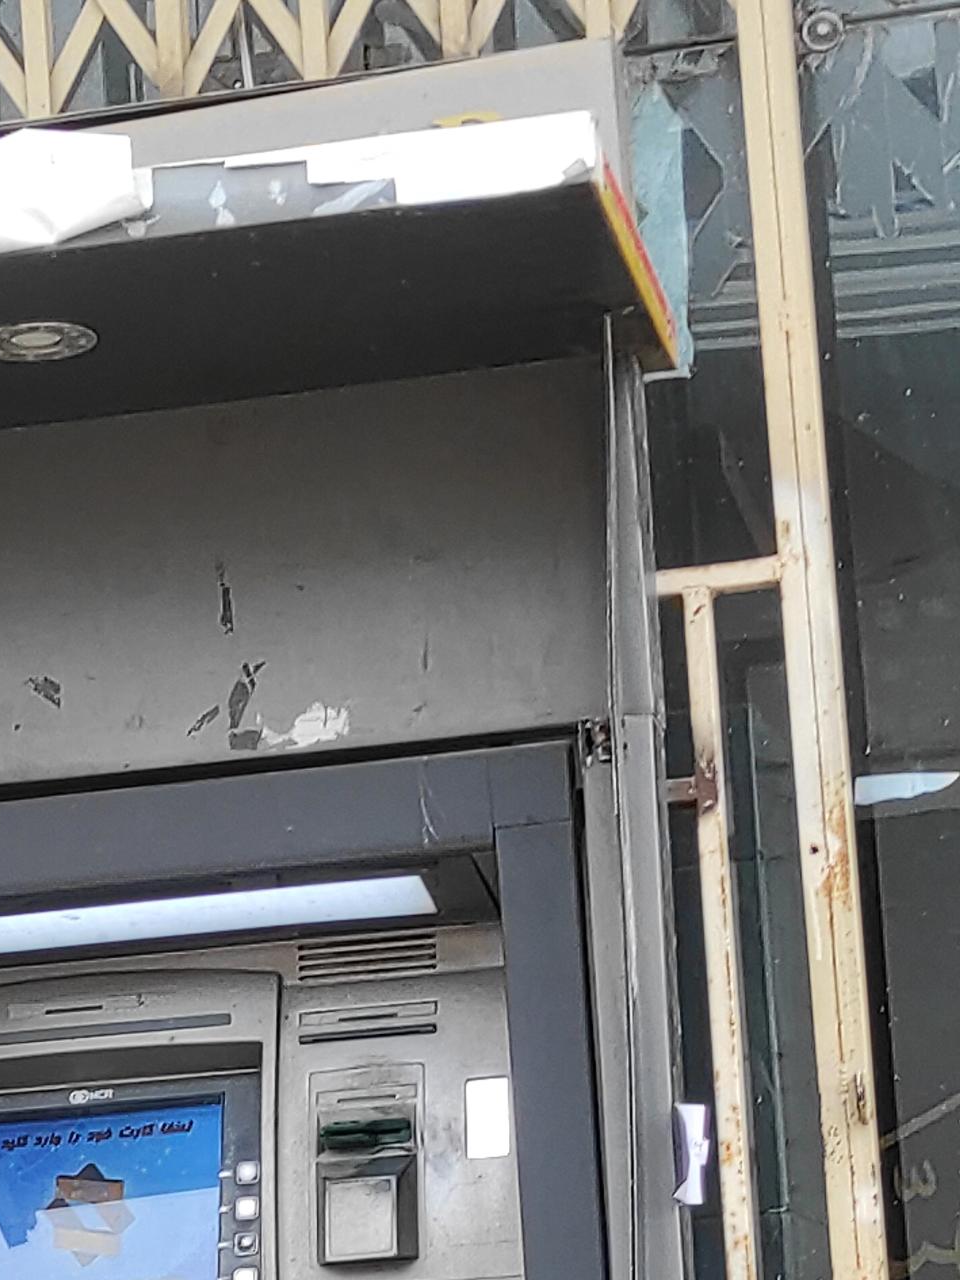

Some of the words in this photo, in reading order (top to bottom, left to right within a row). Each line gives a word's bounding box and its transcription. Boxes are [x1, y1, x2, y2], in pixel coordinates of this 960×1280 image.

[68, 1131, 82, 1145] را
[87, 1128, 113, 1143] خود
[119, 1124, 156, 1140] کارت
[33, 1132, 62, 1148] وارد
